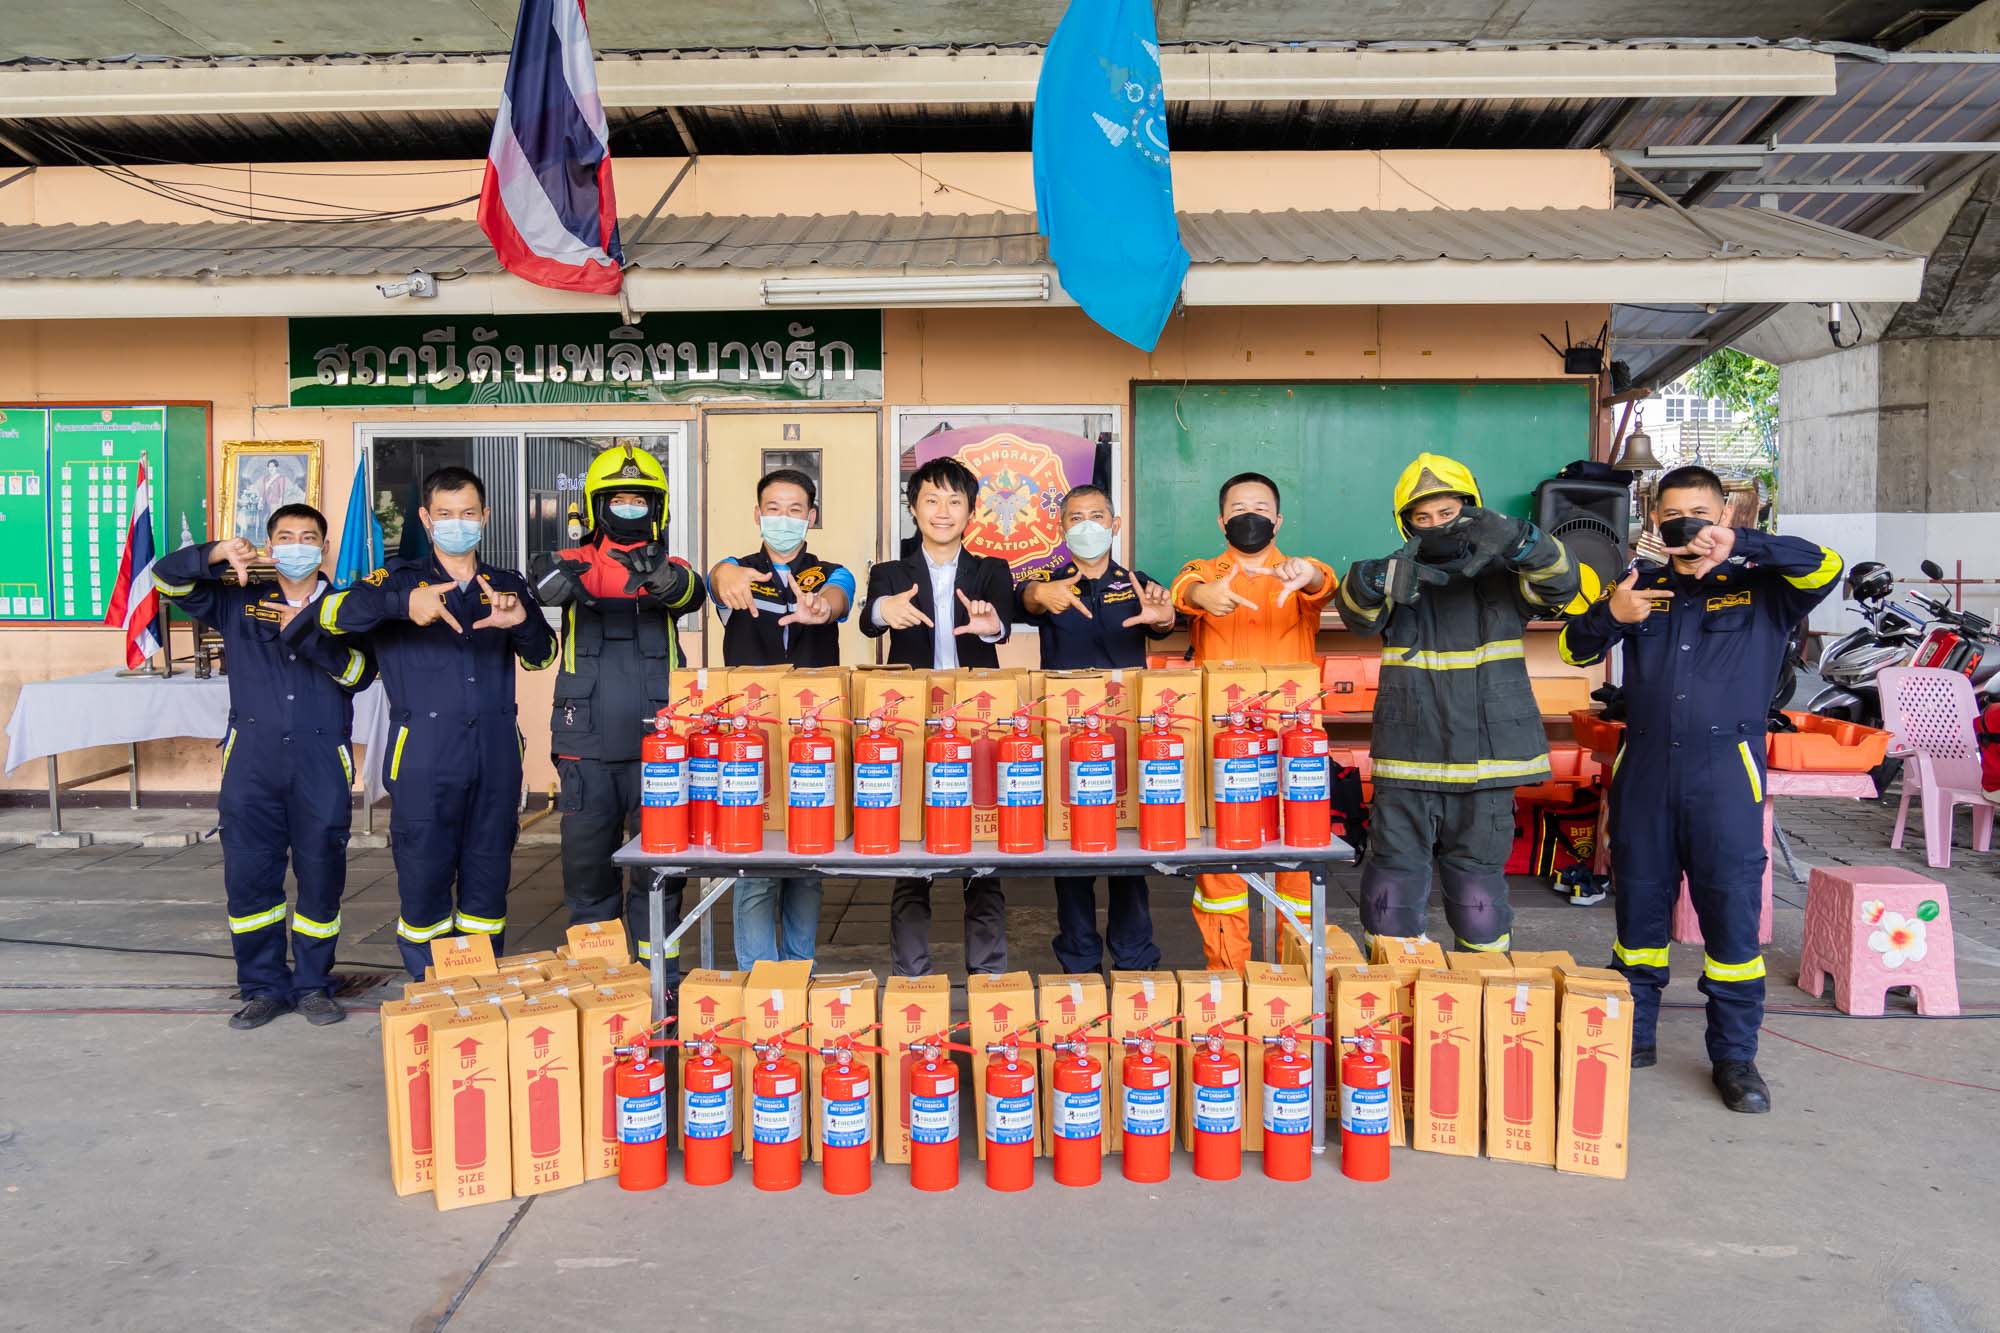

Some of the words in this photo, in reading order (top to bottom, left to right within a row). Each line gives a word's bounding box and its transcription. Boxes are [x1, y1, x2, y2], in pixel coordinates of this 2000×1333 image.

[313, 322, 855, 386] สถานีดับเพลิงบางรัก
[972, 450, 1038, 467] BANGRAK
[975, 536, 1040, 551] STATION
[691, 699, 703, 707] UP
[978, 712, 990, 720] UP
[1067, 708, 1079, 717] UP
[975, 814, 997, 822] SIZE
[975, 825, 980, 833] 5
[984, 824, 997, 833] LB
[579, 936, 615, 950] ห้ามโยน
[444, 954, 482, 968] ห้ามโยน
[1397, 954, 1436, 965] ห้ามโยน
[1134, 1012, 1148, 1021] UP
[1202, 1013, 1216, 1023] UP
[1361, 1009, 1375, 1019] UP
[1439, 1012, 1453, 1023] UP
[701, 1017, 714, 1025] UP
[765, 1019, 779, 1028] UP
[832, 1019, 845, 1028] UP
[1062, 1016, 1076, 1025] UP
[1270, 1018, 1285, 1027] UP
[1511, 1016, 1526, 1025] UP
[907, 1024, 921, 1033] UP
[994, 1023, 1008, 1032] UP
[1587, 1027, 1603, 1037] UP
[610, 1035, 623, 1046] UP
[534, 1050, 549, 1060] UP
[461, 1058, 477, 1069] UP
[1431, 1121, 1456, 1132] SIZE
[1506, 1128, 1532, 1139] SIZE
[1432, 1135, 1437, 1144] 5
[1441, 1135, 1456, 1145] LB
[1506, 1140, 1511, 1149] 5
[1516, 1140, 1532, 1151] LB
[1574, 1141, 1600, 1153] SIZE
[415, 1158, 433, 1169] SIZ
[604, 1159, 610, 1169] 5
[1573, 1153, 1579, 1162] 5
[1584, 1154, 1600, 1166] LB
[534, 1159, 560, 1172] SIZE
[416, 1172, 422, 1182] 5
[427, 1170, 433, 1180] L
[458, 1172, 485, 1185] SIZE
[534, 1174, 540, 1184] 5
[545, 1171, 560, 1182] LB
[458, 1187, 464, 1198] 5
[469, 1183, 485, 1196] LB
